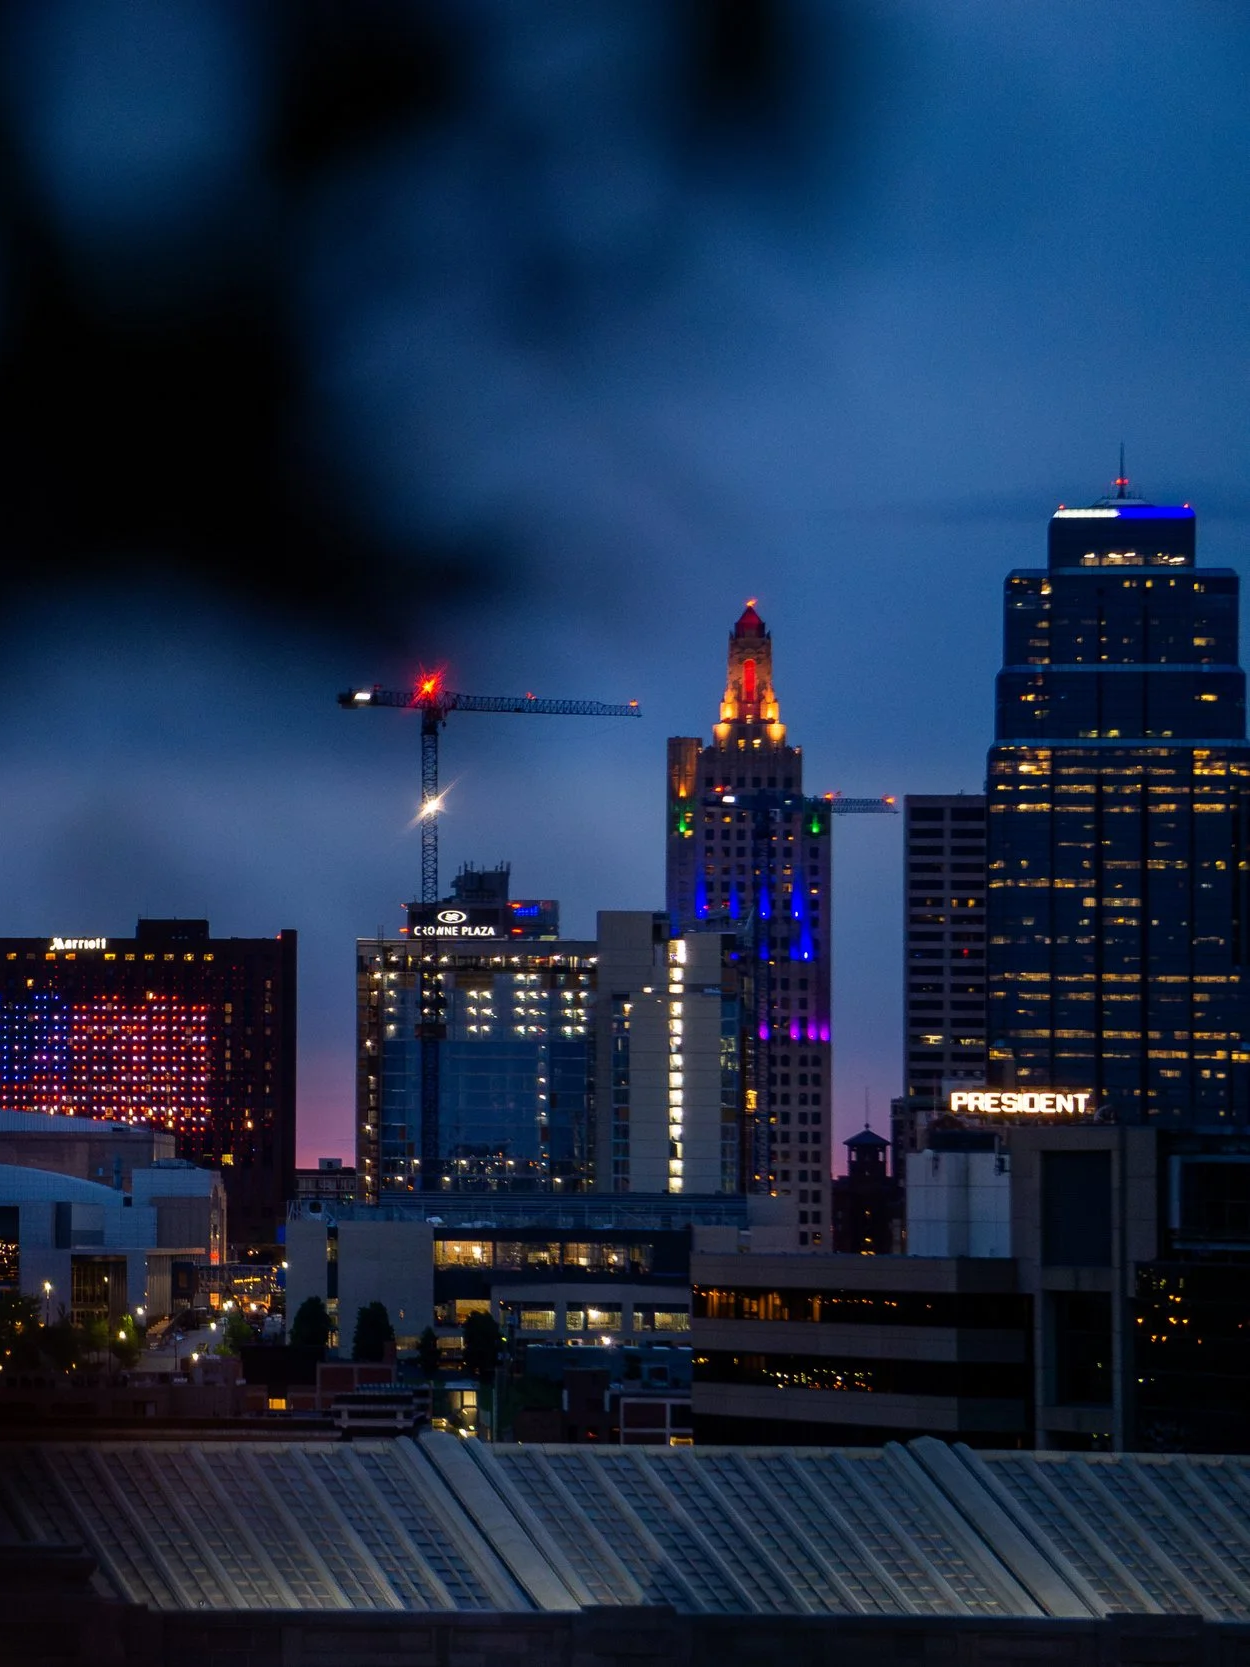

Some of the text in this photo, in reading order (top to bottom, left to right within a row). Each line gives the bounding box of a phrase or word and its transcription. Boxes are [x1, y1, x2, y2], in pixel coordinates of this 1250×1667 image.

[461, 926, 496, 936] PLAZA
[49, 937, 107, 951] Marriott
[950, 1092, 1089, 1114] PRESIDENT
